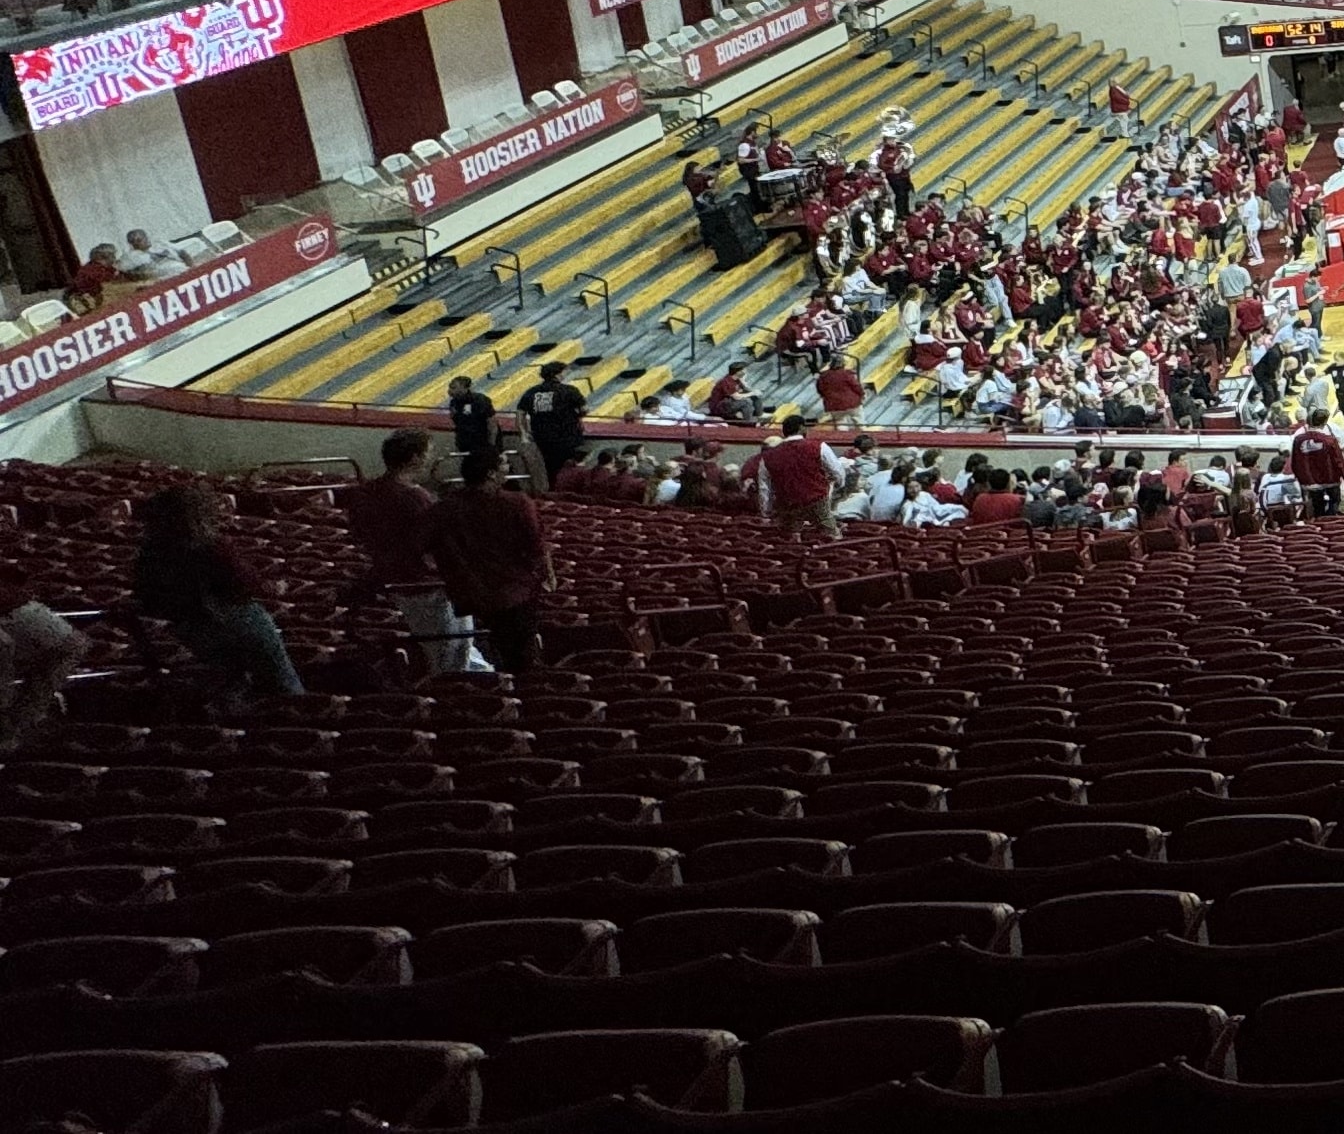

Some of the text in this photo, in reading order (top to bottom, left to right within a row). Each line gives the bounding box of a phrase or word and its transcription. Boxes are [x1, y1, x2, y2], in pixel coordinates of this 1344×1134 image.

[714, 25, 768, 66] HOOSIER
[766, 6, 808, 41] NATION
[459, 127, 543, 184] HOOSIER
[541, 98, 605, 146] NATION
[138, 257, 252, 333] NATION
